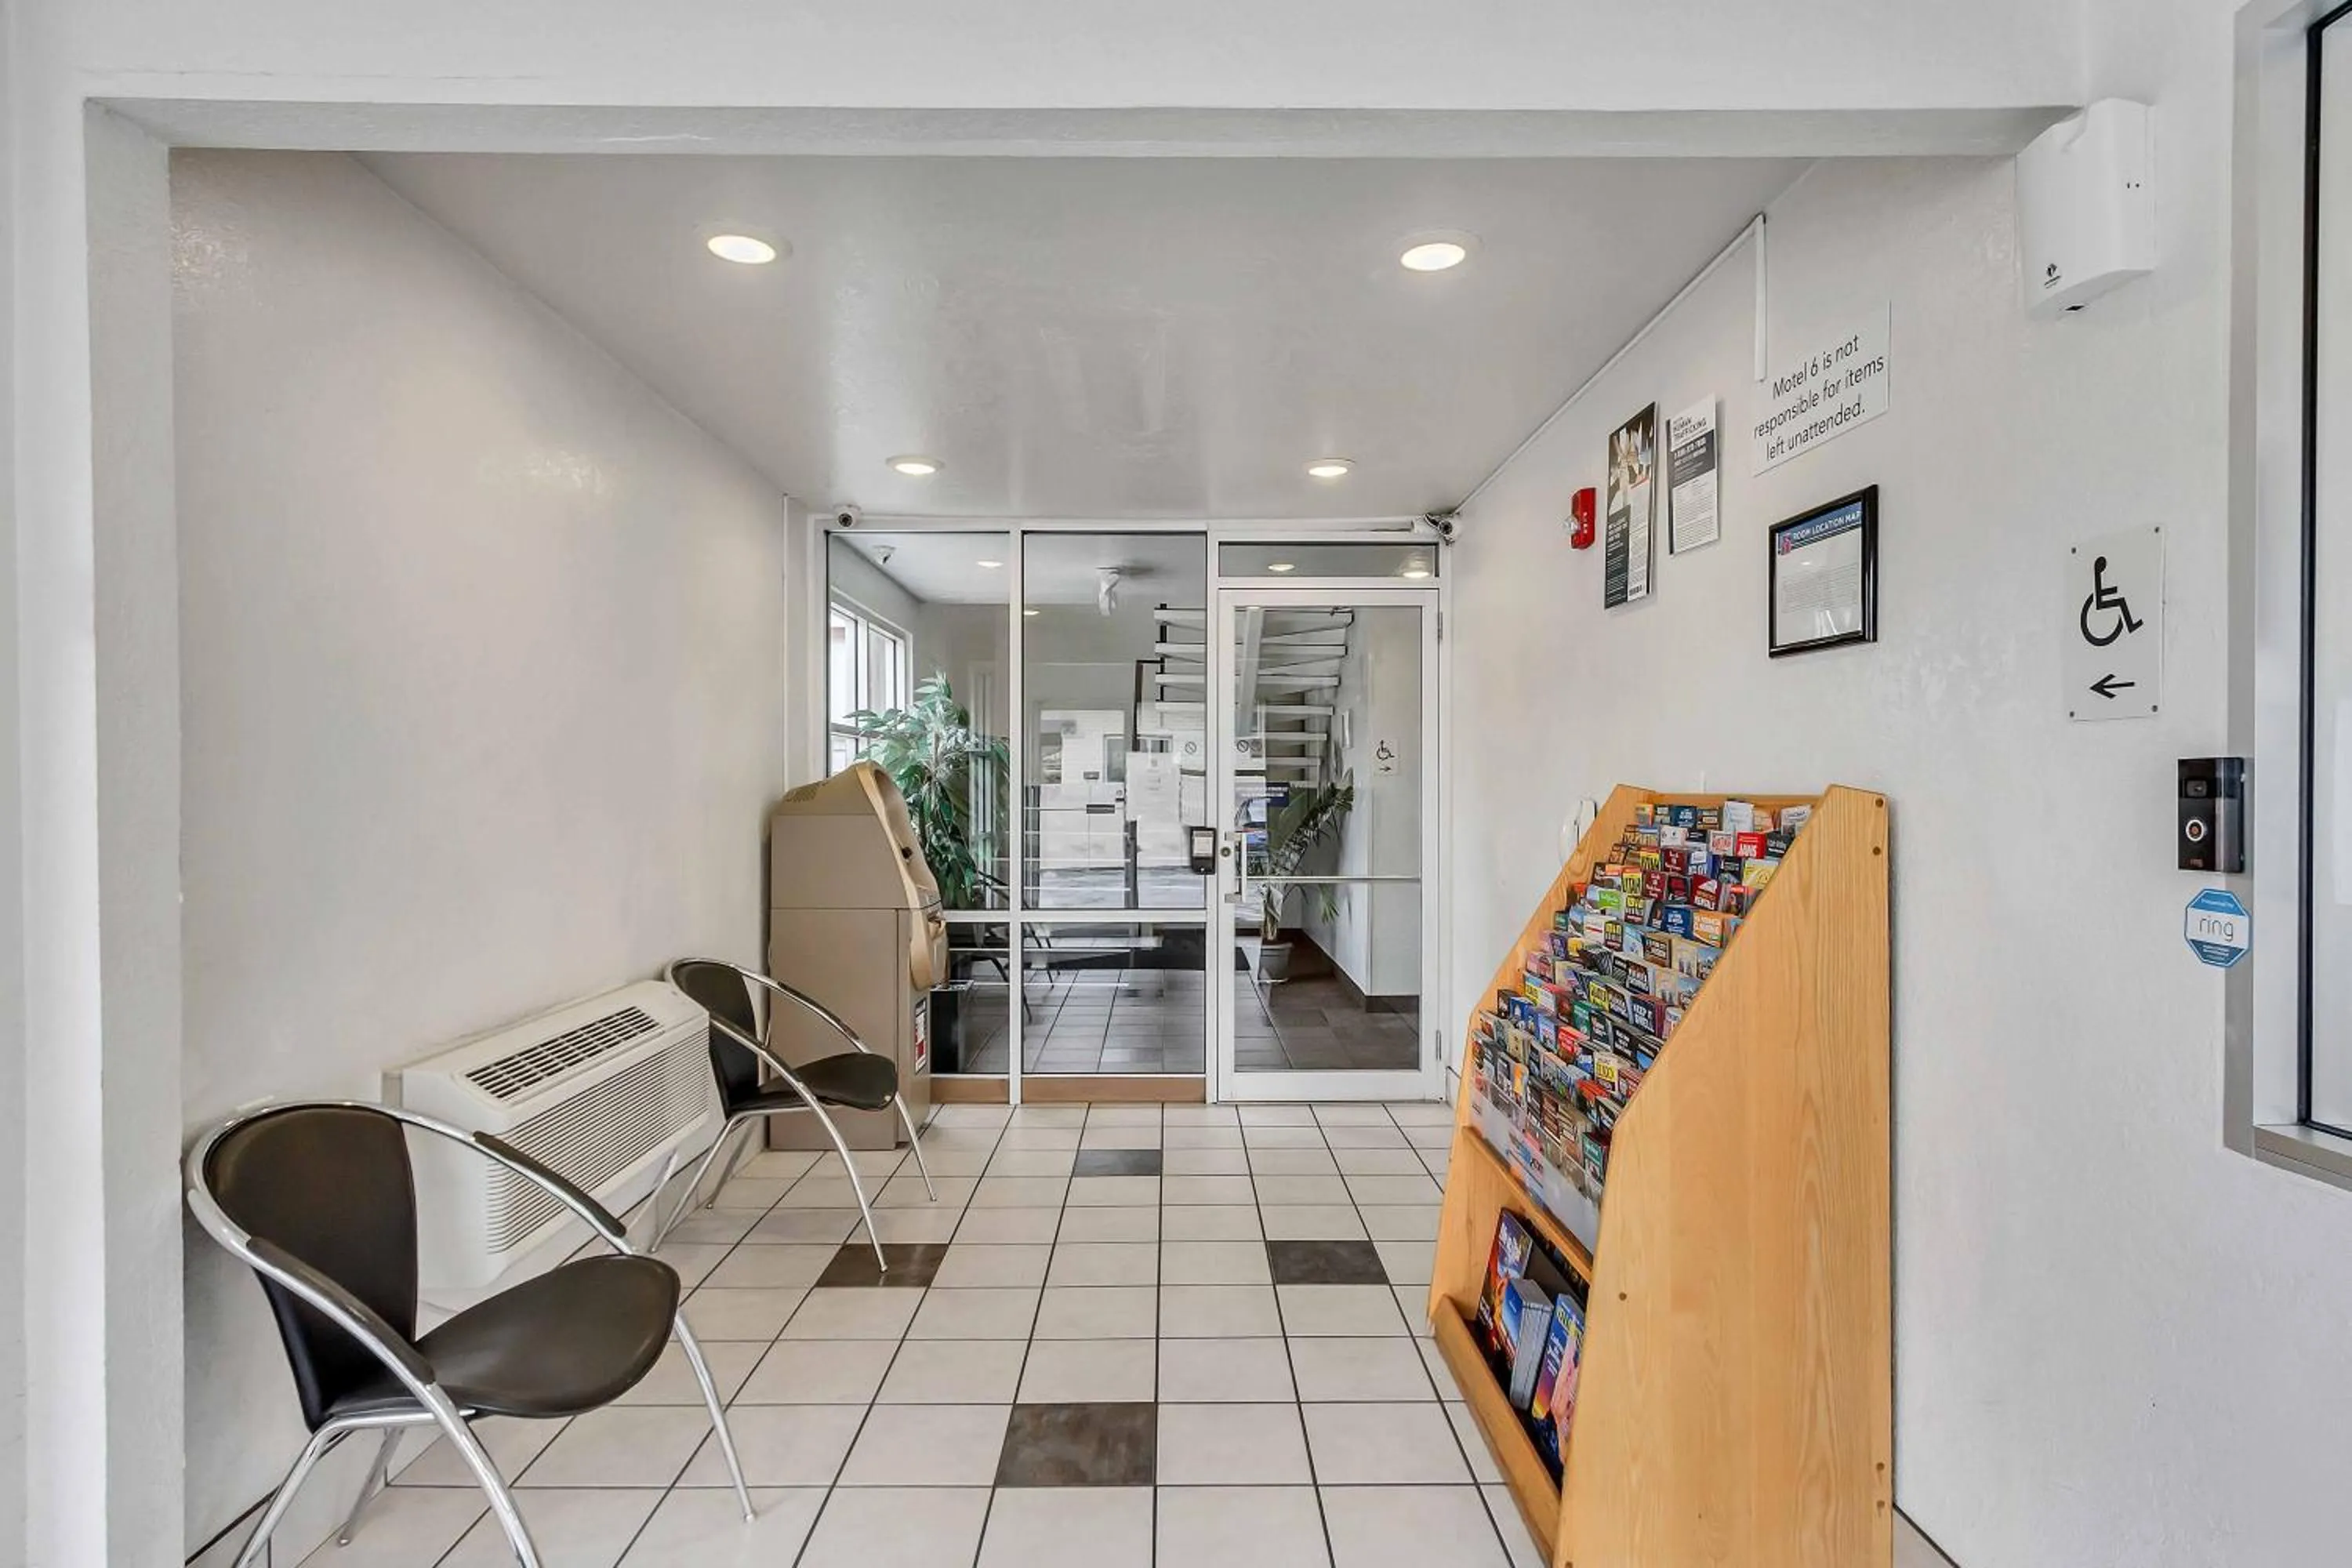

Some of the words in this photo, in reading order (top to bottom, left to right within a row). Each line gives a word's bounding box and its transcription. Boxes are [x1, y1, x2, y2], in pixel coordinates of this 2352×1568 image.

[1754, 389, 1820, 439] responsible
[1823, 379, 1842, 402] for
[1845, 355, 1885, 389] items
[1772, 361, 1807, 400] Motel
[1810, 356, 1819, 377] 6
[1823, 350, 1832, 371] is
[1835, 334, 1859, 363] not
[1766, 435, 1785, 462] left
[1788, 393, 1866, 451] unattended.
[1812, 516, 1846, 535] LOCATION
[2199, 915, 2234, 942] ring
